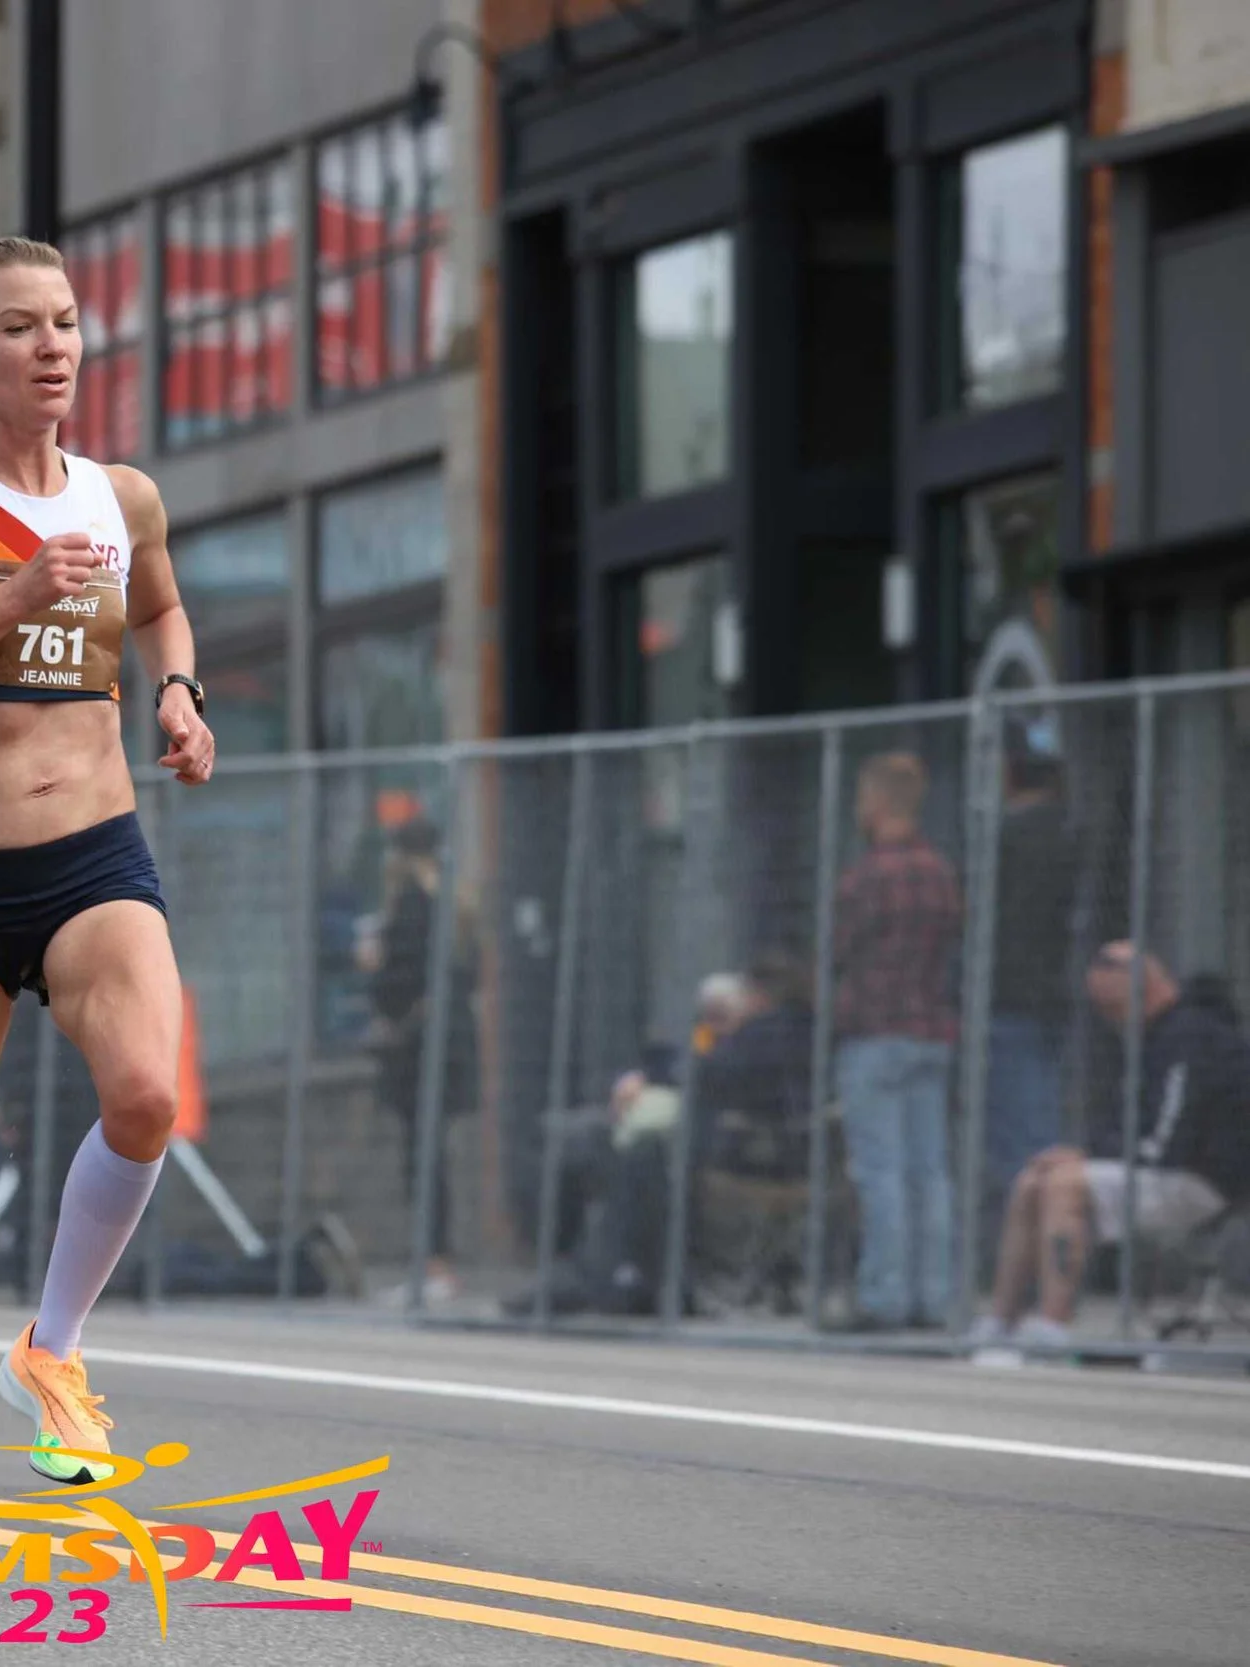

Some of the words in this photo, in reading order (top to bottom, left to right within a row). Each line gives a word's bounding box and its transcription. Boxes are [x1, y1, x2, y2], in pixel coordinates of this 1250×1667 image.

[50, 599, 99, 613] MSDAY
[17, 624, 85, 666] 761
[18, 669, 83, 687] JEANNIE
